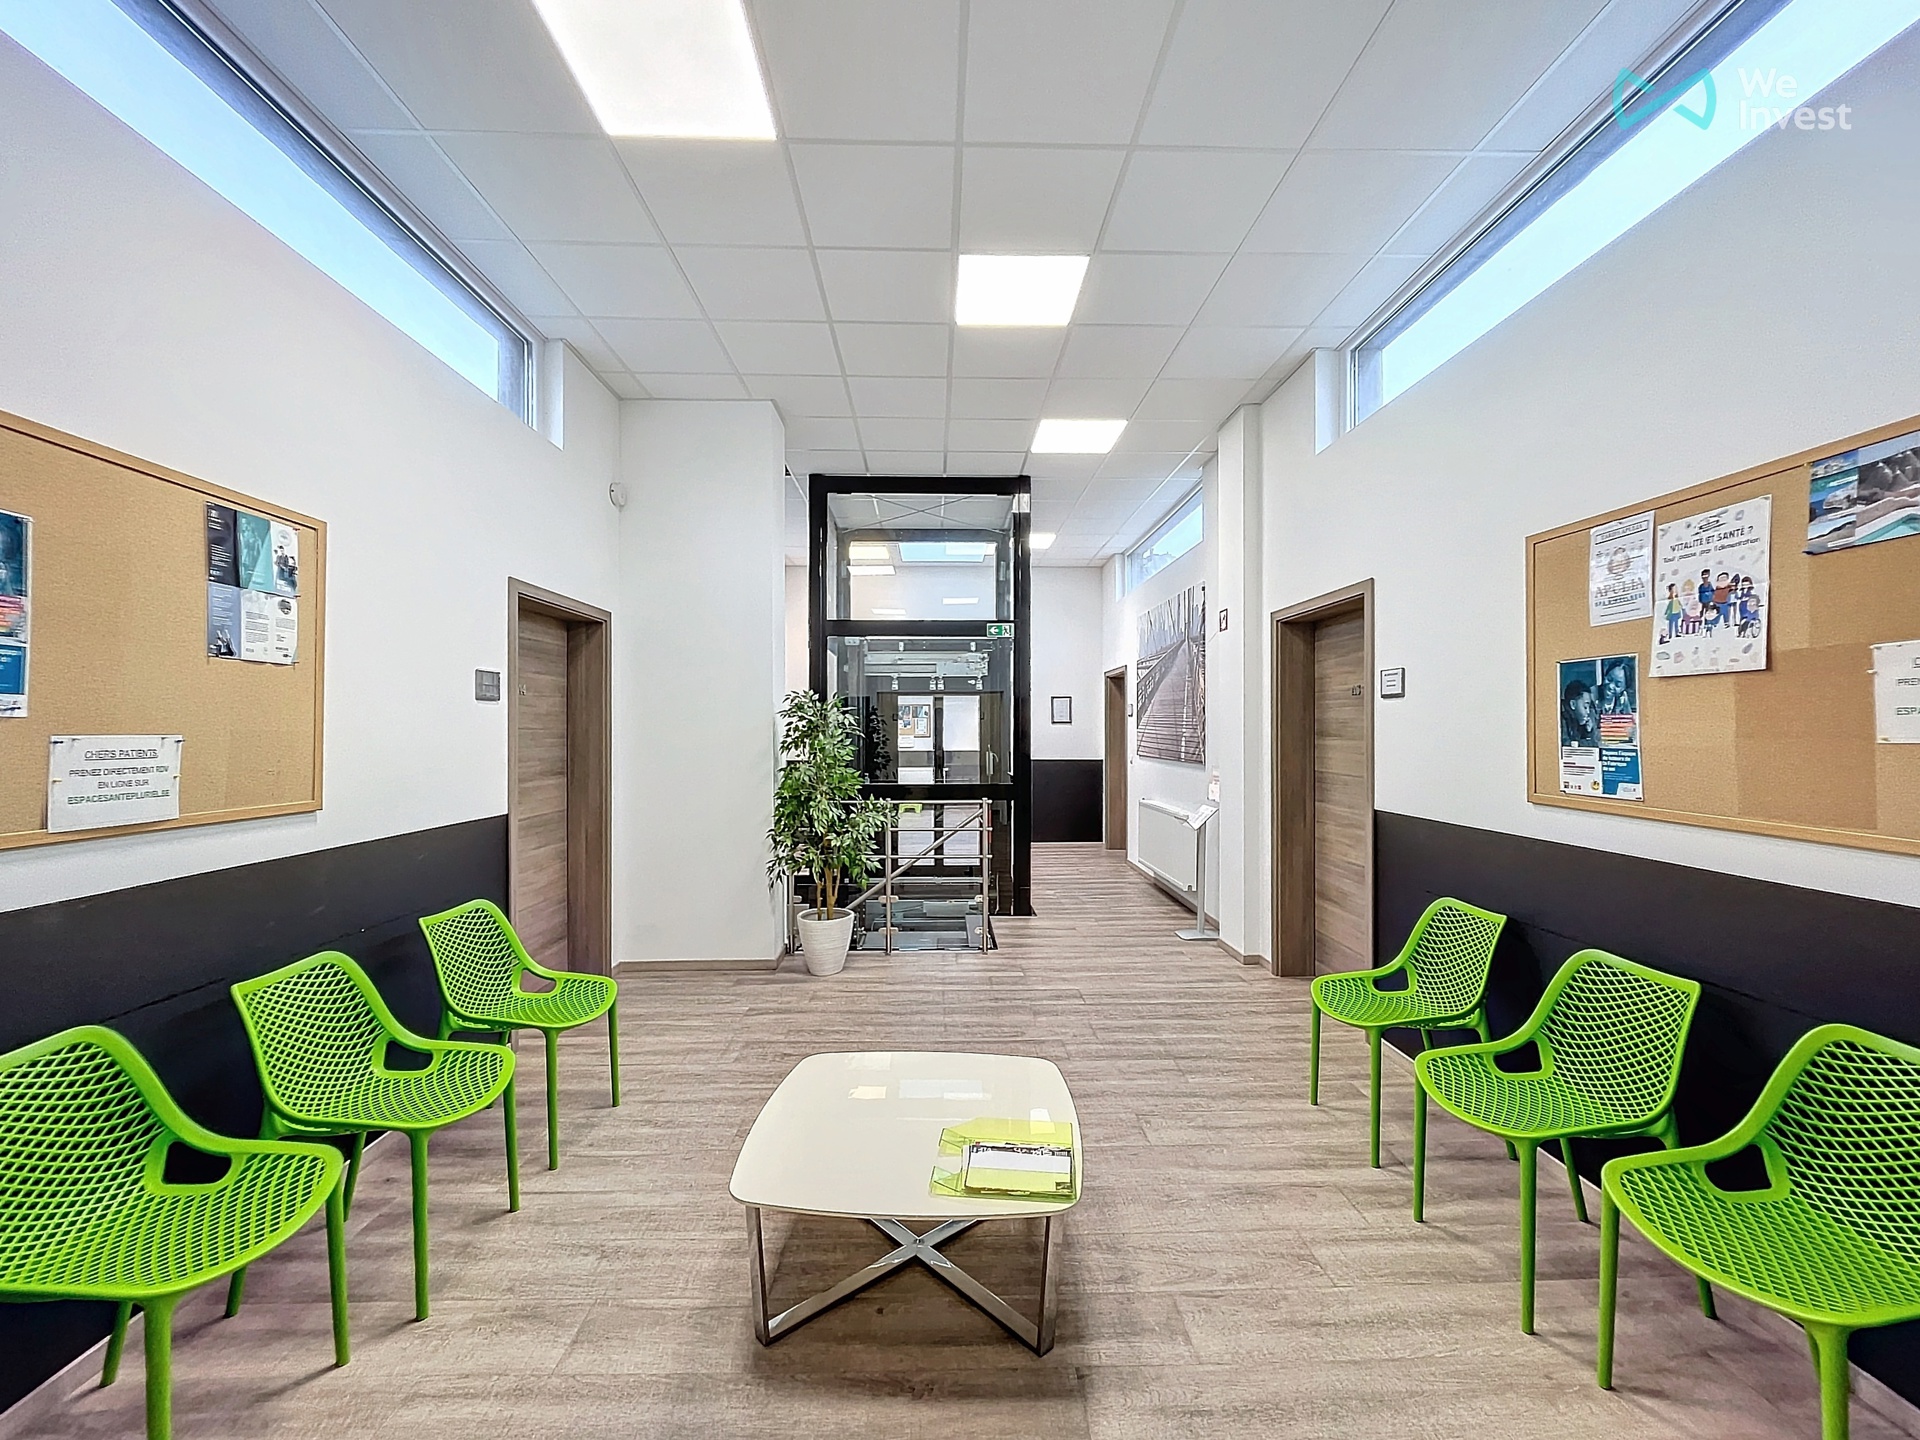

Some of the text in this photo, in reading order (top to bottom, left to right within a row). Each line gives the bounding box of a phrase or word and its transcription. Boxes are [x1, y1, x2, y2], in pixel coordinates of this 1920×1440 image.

[1706, 534, 1715, 544] ET
[84, 749, 117, 760] CHERS
[69, 765, 170, 777] PRENEZ DIRECTEMENT RDV
[98, 778, 150, 789] EN LIGNE SUR
